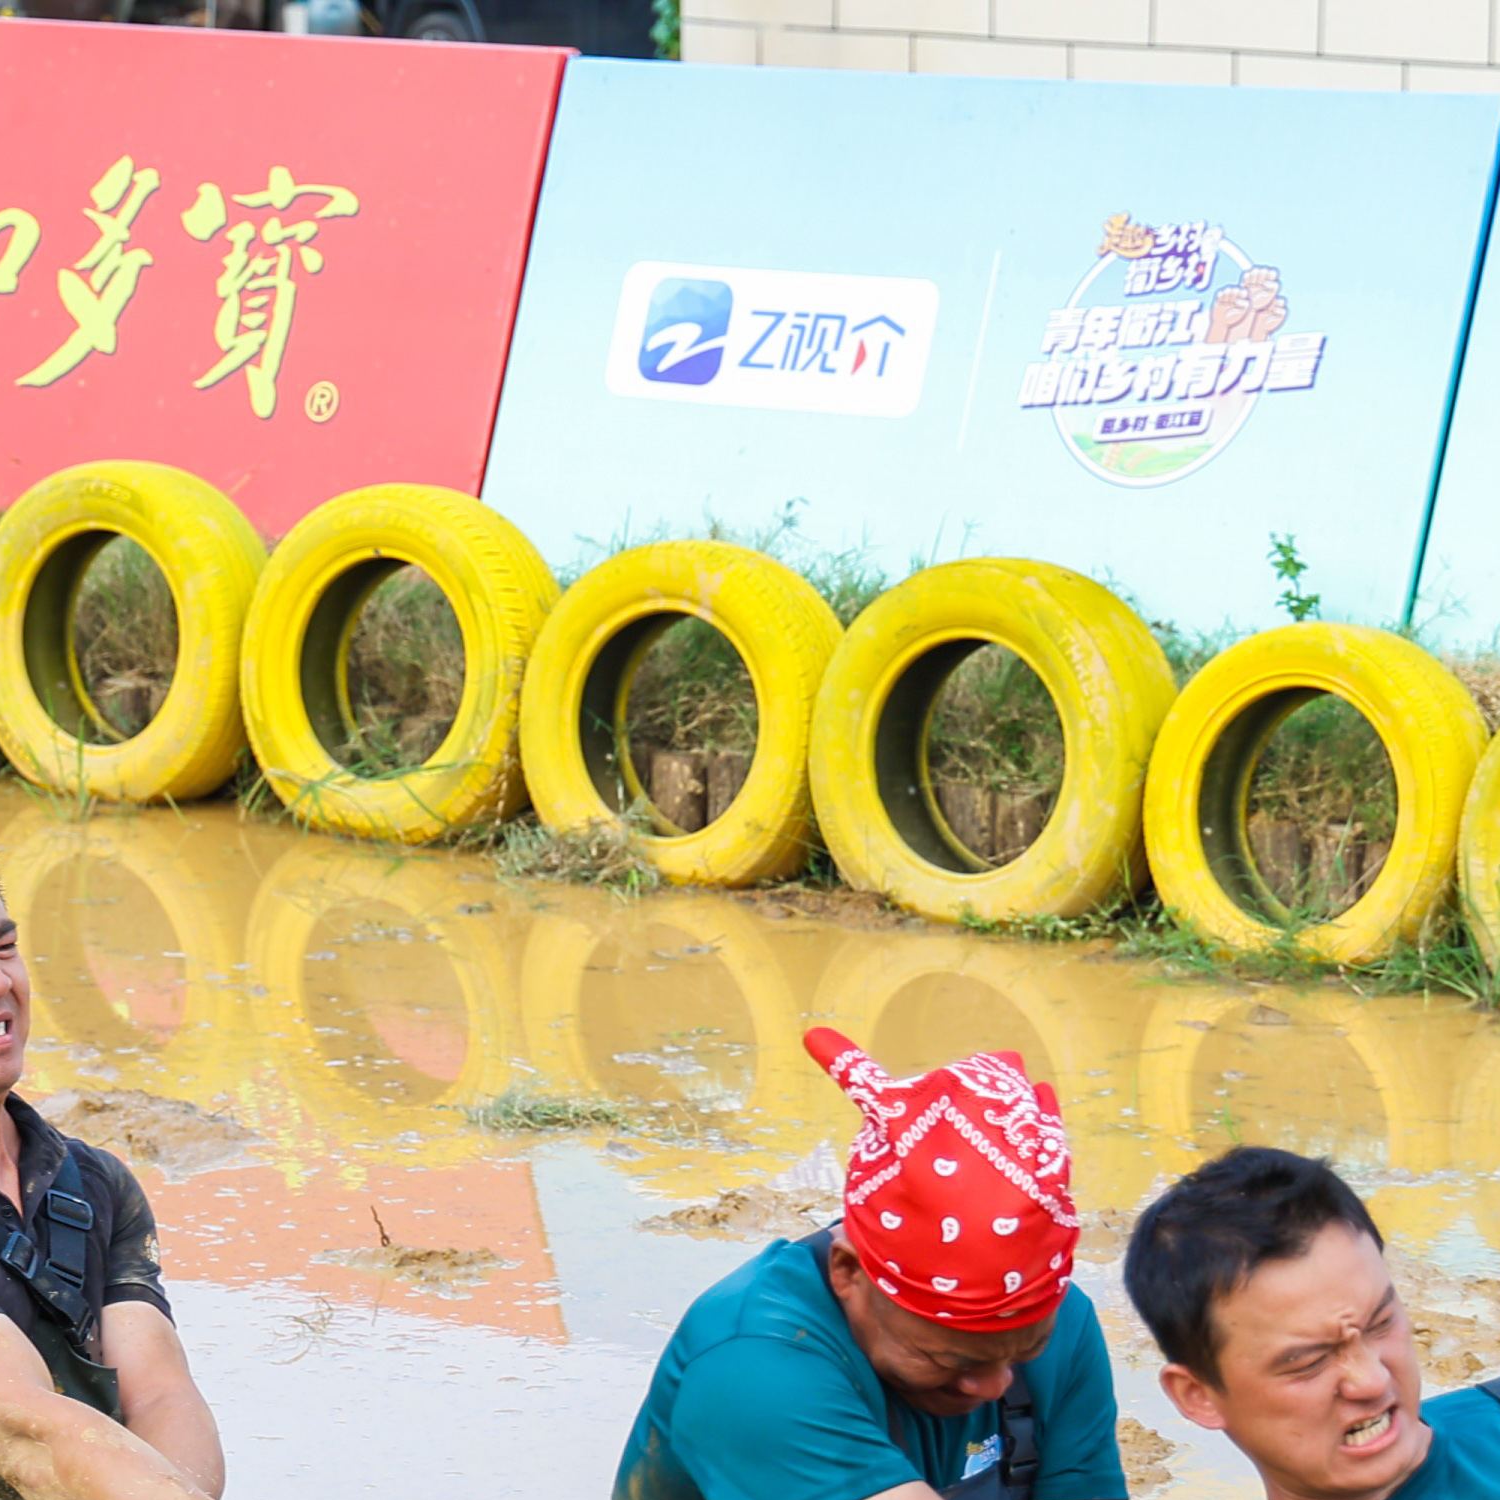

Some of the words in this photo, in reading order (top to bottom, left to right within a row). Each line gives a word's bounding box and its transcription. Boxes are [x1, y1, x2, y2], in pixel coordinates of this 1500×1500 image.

[737, 309, 906, 378] Z视介
[1017, 330, 1328, 410] 咱们乡村有力量
